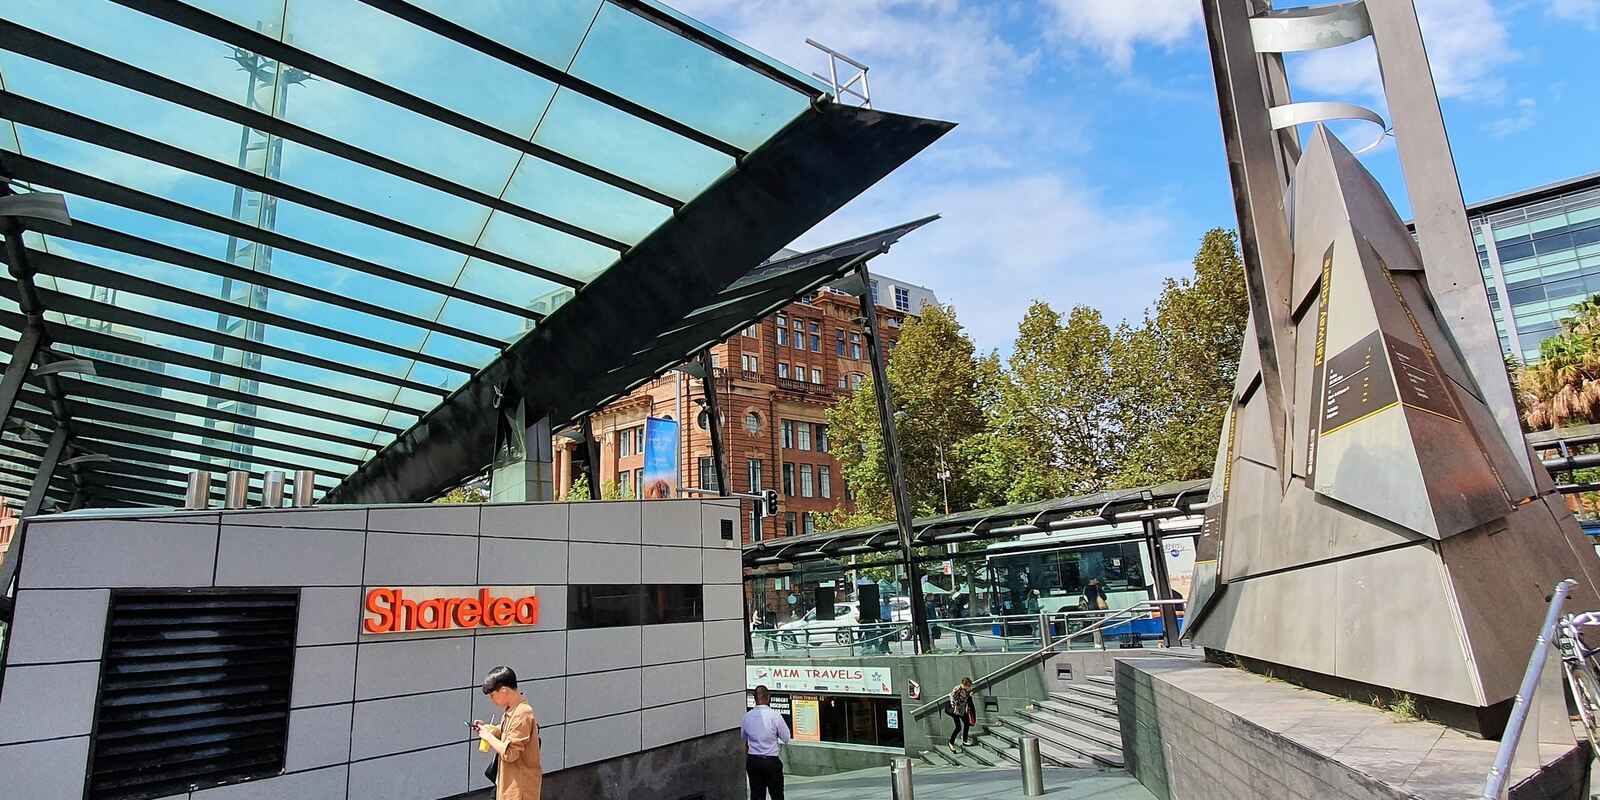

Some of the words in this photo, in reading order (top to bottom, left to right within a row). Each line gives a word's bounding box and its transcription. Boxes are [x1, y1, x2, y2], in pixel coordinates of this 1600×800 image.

[1319, 257, 1332, 308] Square
[1314, 311, 1328, 367] Railway
[365, 588, 538, 633] Sharetea
[772, 668, 800, 678] MIM
[806, 669, 863, 680] TRAVELS
